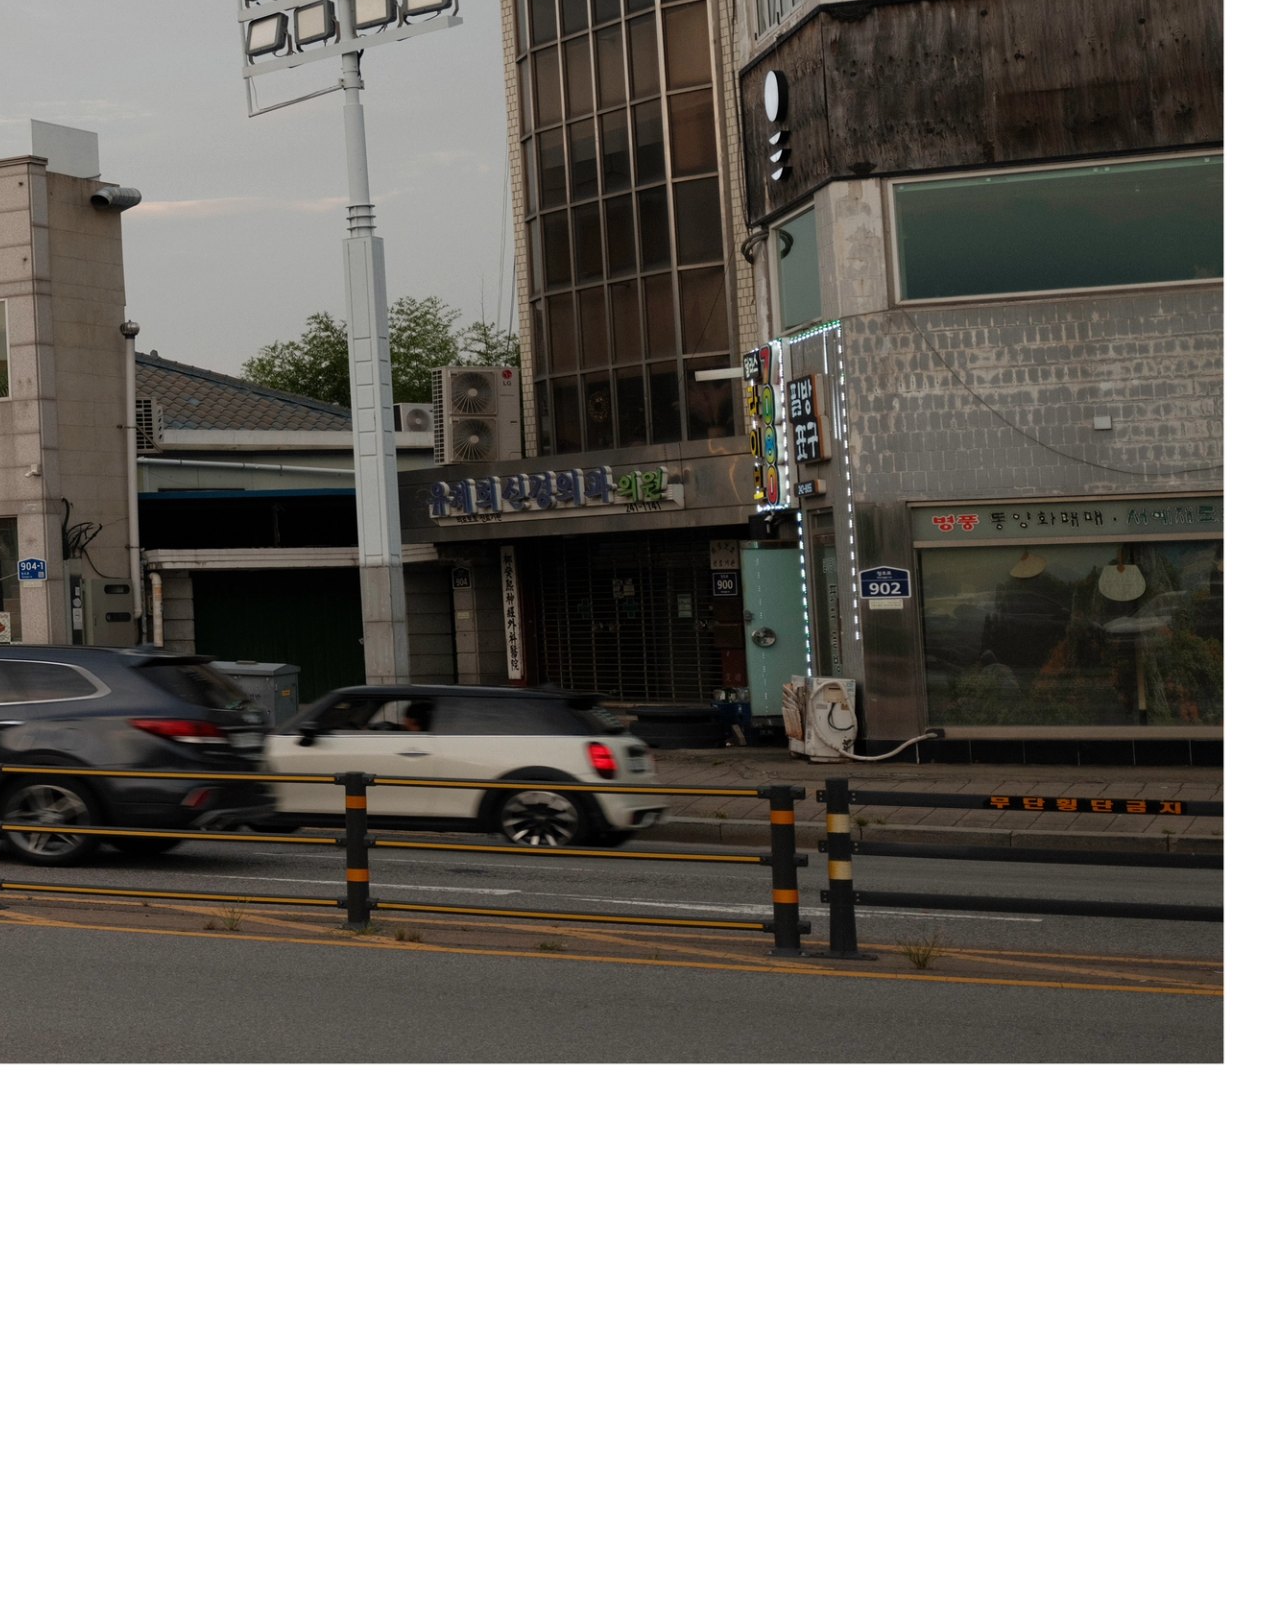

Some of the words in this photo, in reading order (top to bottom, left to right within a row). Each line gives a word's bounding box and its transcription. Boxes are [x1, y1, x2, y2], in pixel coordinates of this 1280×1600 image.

[759, 343, 779, 505] 7080
[795, 421, 819, 461] 표구
[618, 465, 669, 502] 의원
[932, 513, 979, 532] 병풍
[990, 510, 1104, 530] 동양화매매
[20, 561, 44, 571] 904-1
[717, 579, 733, 590] 900
[869, 582, 902, 595] 902
[990, 796, 1182, 815] 무단횡단금지
